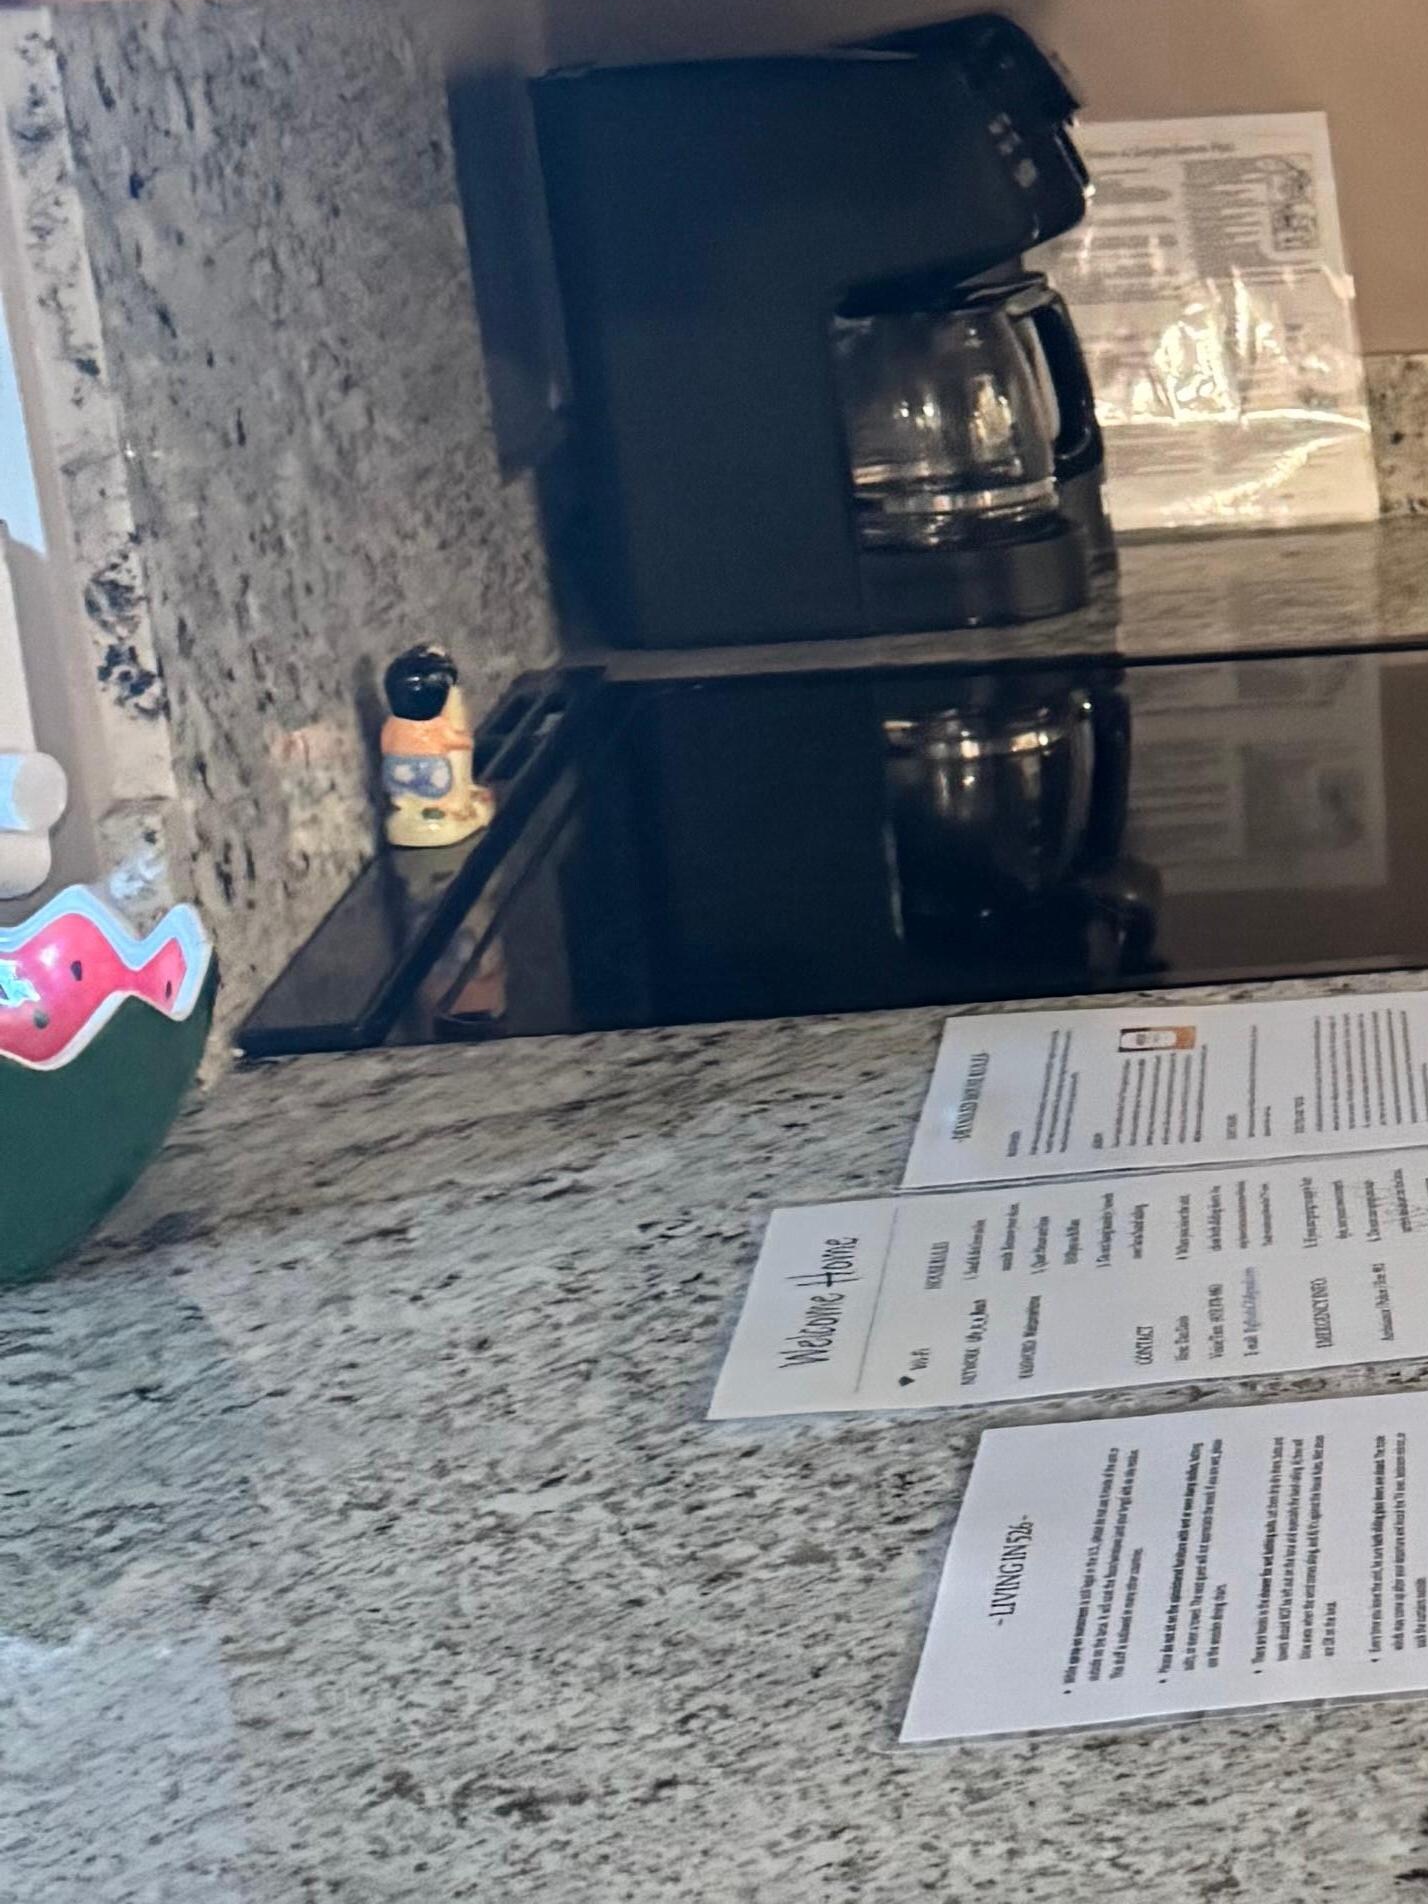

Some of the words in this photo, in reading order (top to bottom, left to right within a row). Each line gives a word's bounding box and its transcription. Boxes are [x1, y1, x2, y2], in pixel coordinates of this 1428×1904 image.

[787, 1237, 859, 1287] Home
[778, 1292, 845, 1368] Welcome
[1134, 1326, 1153, 1365] CONTACT
[1000, 1544, 1027, 1561] IN
[1005, 1521, 1033, 1543] 526
[988, 1563, 1023, 1616] LIVING
